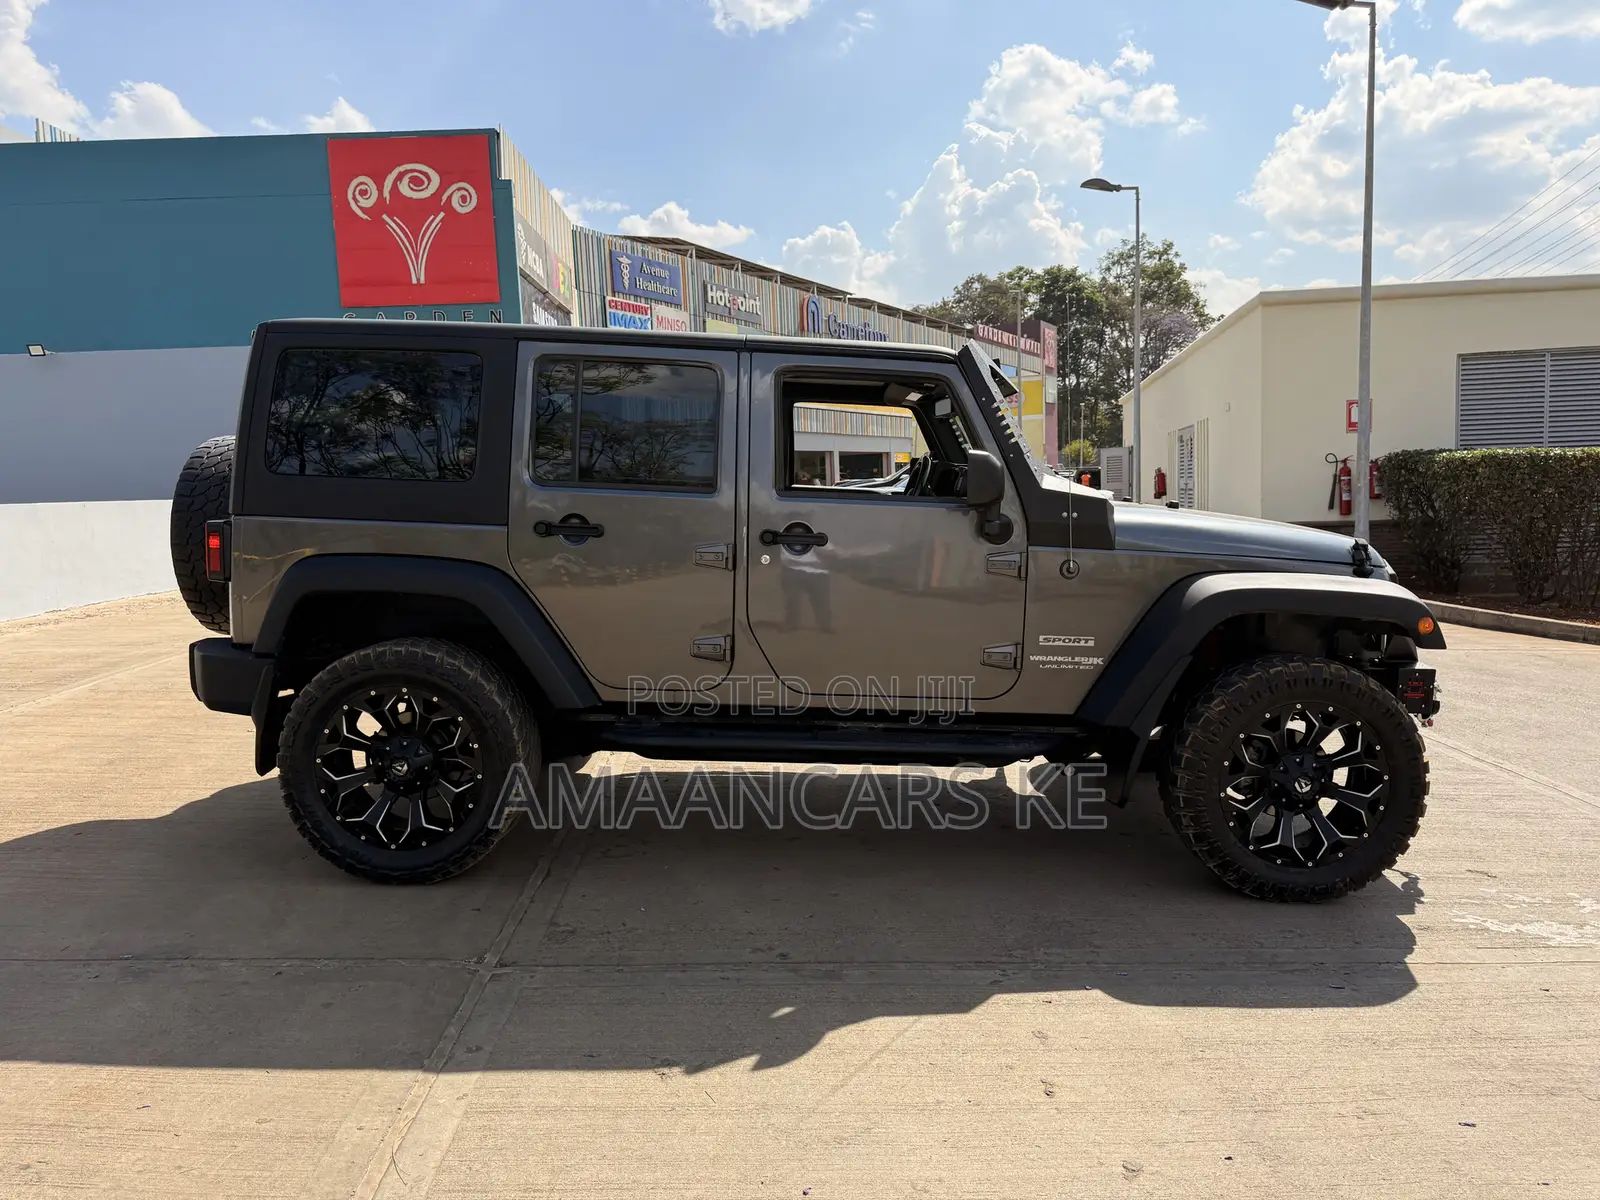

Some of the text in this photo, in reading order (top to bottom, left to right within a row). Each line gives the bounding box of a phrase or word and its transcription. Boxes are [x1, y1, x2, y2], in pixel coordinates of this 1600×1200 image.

[527, 244, 544, 279] NCBA
[641, 262, 670, 279] Avenue
[635, 276, 678, 297] Healthcare
[608, 299, 650, 316] CENTURY
[707, 284, 761, 316] Hotpoint
[608, 311, 650, 330] IMAX
[656, 315, 687, 332] MINISO
[828, 312, 889, 342] Carrefour
[1041, 636, 1093, 645] SPORT
